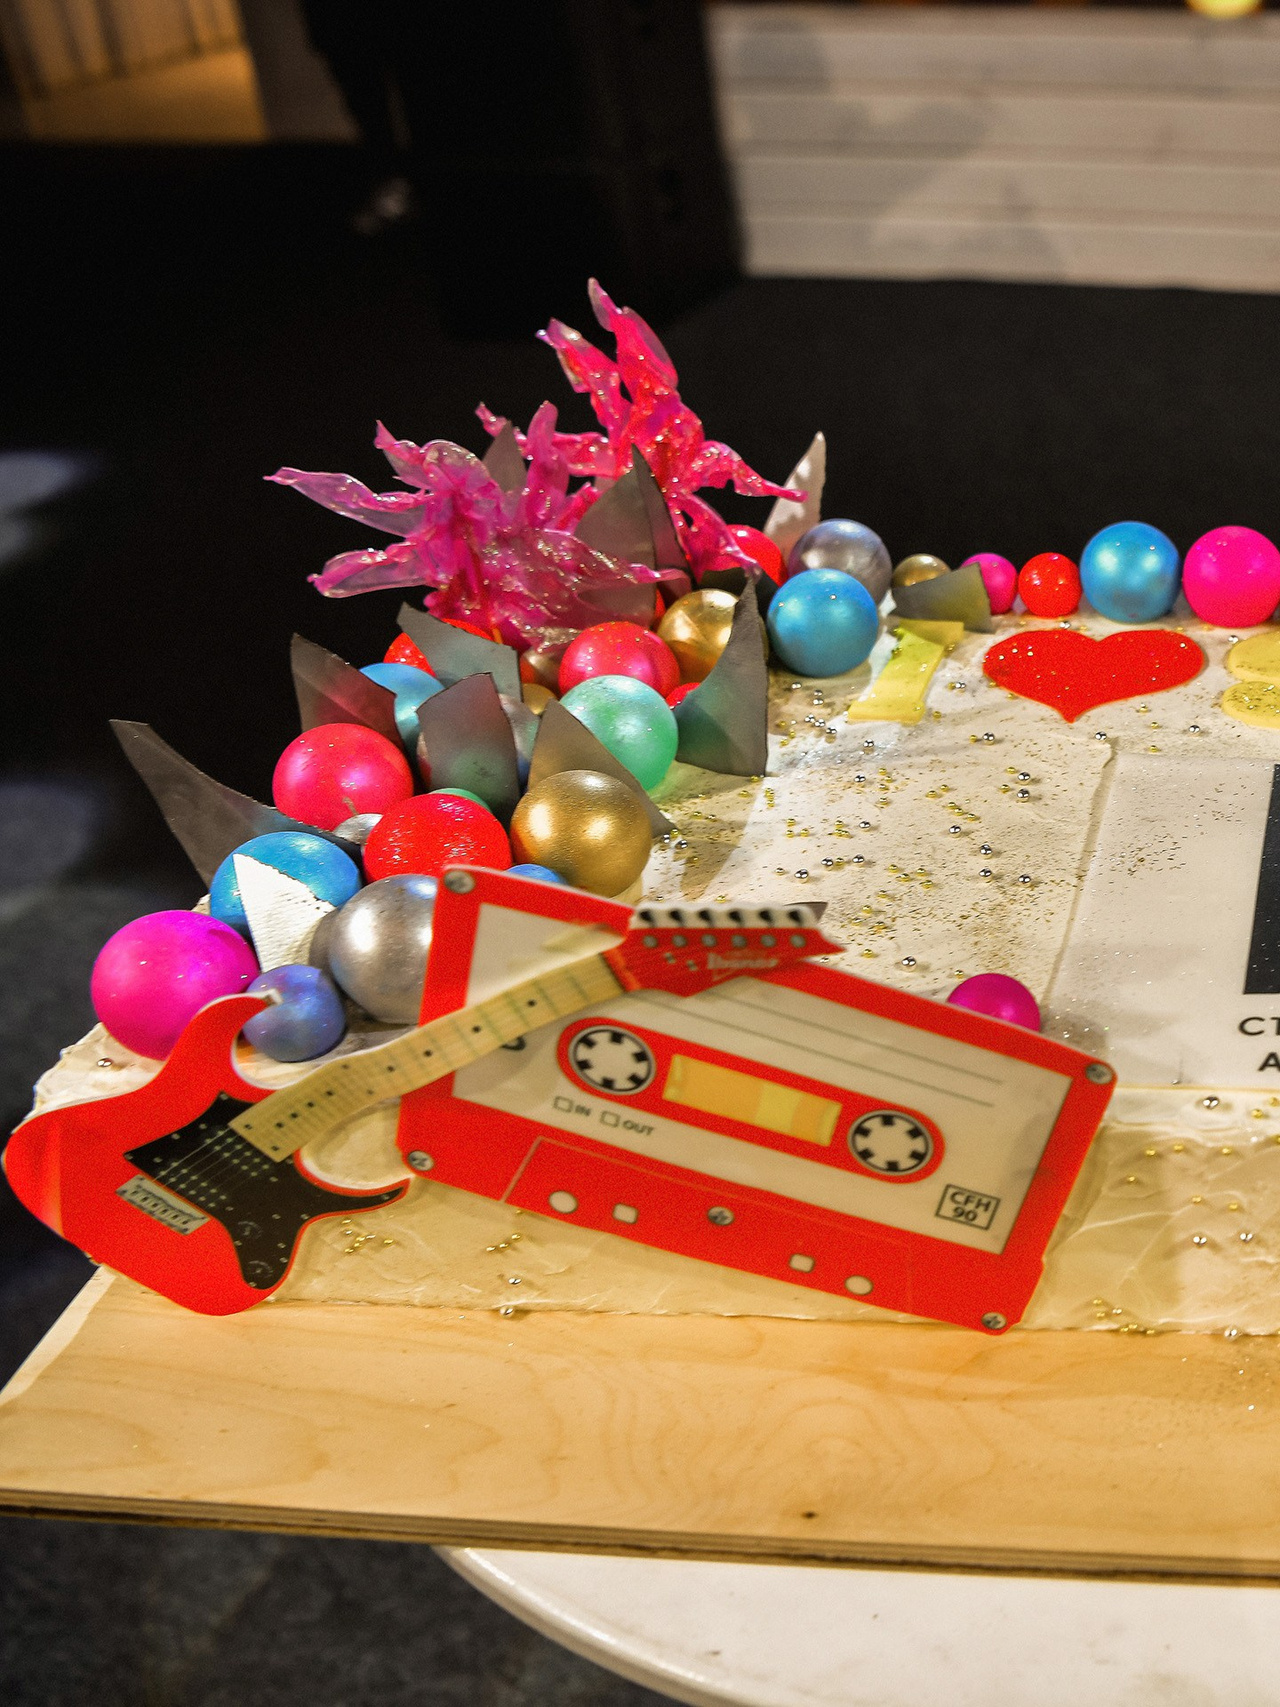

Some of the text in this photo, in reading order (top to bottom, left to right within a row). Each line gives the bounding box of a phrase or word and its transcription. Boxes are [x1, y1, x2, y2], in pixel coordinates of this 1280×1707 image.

[847, 619, 965, 725] I
[622, 1119, 655, 1136] OUT
[950, 1191, 992, 1212] CFH
[952, 1206, 978, 1222] 90
